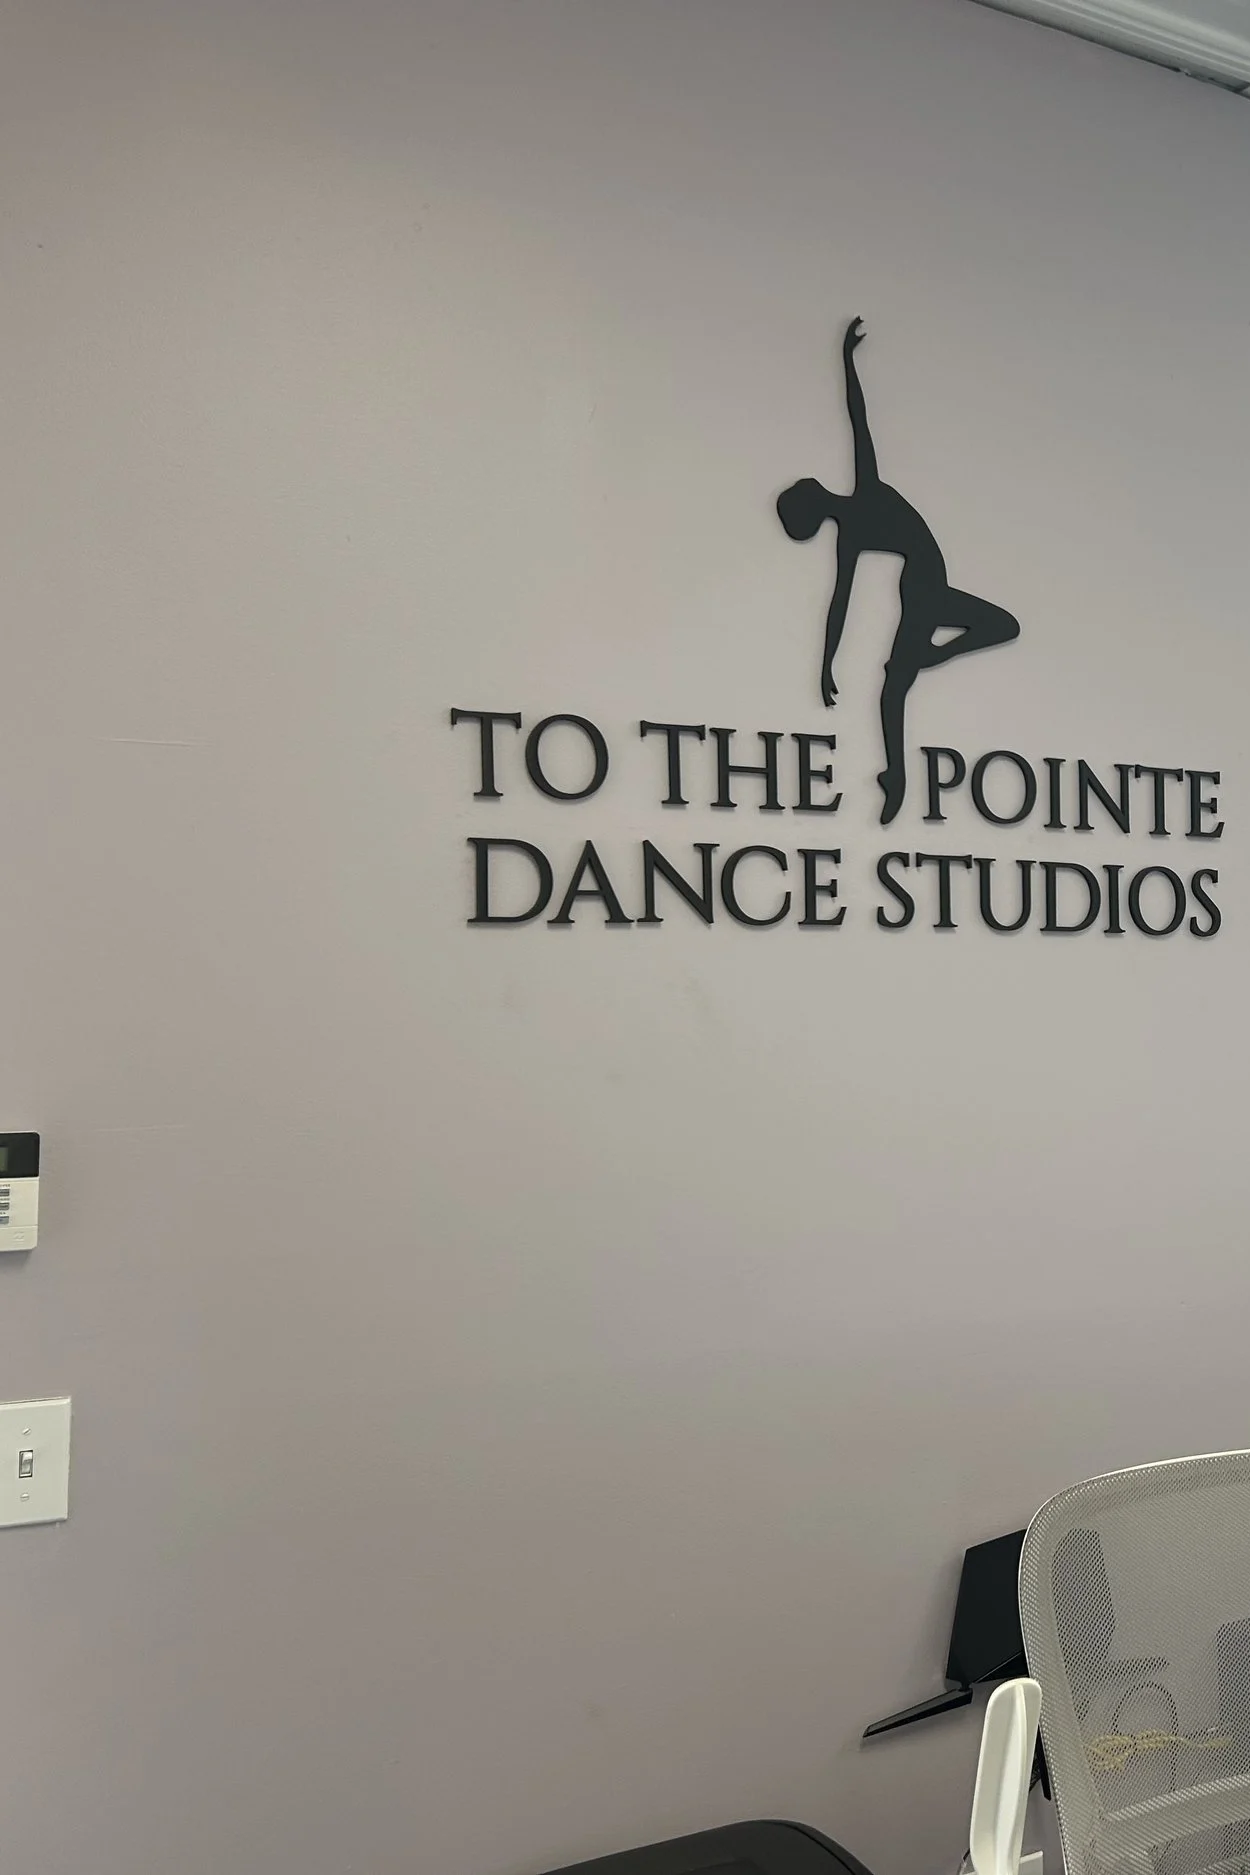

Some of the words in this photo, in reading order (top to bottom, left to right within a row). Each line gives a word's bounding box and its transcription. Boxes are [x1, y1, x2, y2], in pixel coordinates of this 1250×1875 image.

[450, 707, 610, 802] TO
[639, 720, 843, 814] THE
[919, 746, 1225, 839] POINTE
[466, 836, 848, 928] DANCE
[876, 851, 1223, 938] STUDIOS
